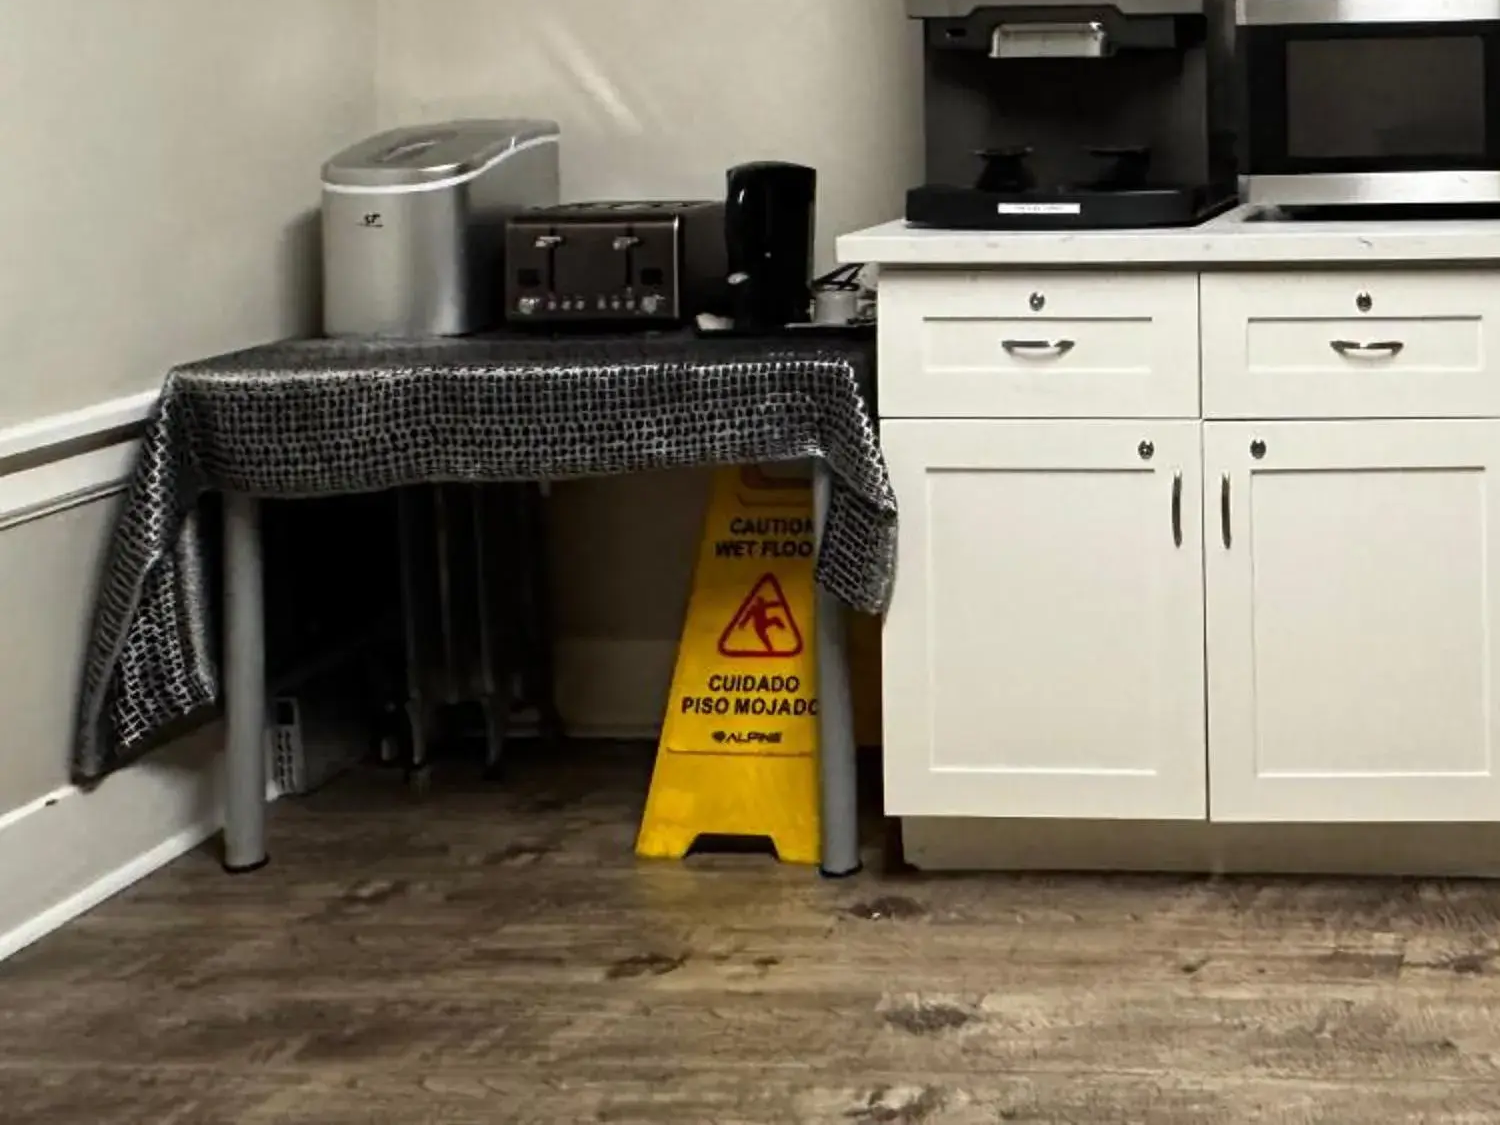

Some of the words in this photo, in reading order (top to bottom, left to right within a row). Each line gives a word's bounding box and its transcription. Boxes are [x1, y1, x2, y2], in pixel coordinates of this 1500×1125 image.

[715, 540, 758, 557] WET
[761, 541, 815, 557] FLOO
[708, 675, 800, 693] CUIDADO
[681, 696, 730, 714] PISO
[726, 732, 783, 744] ALPINE
